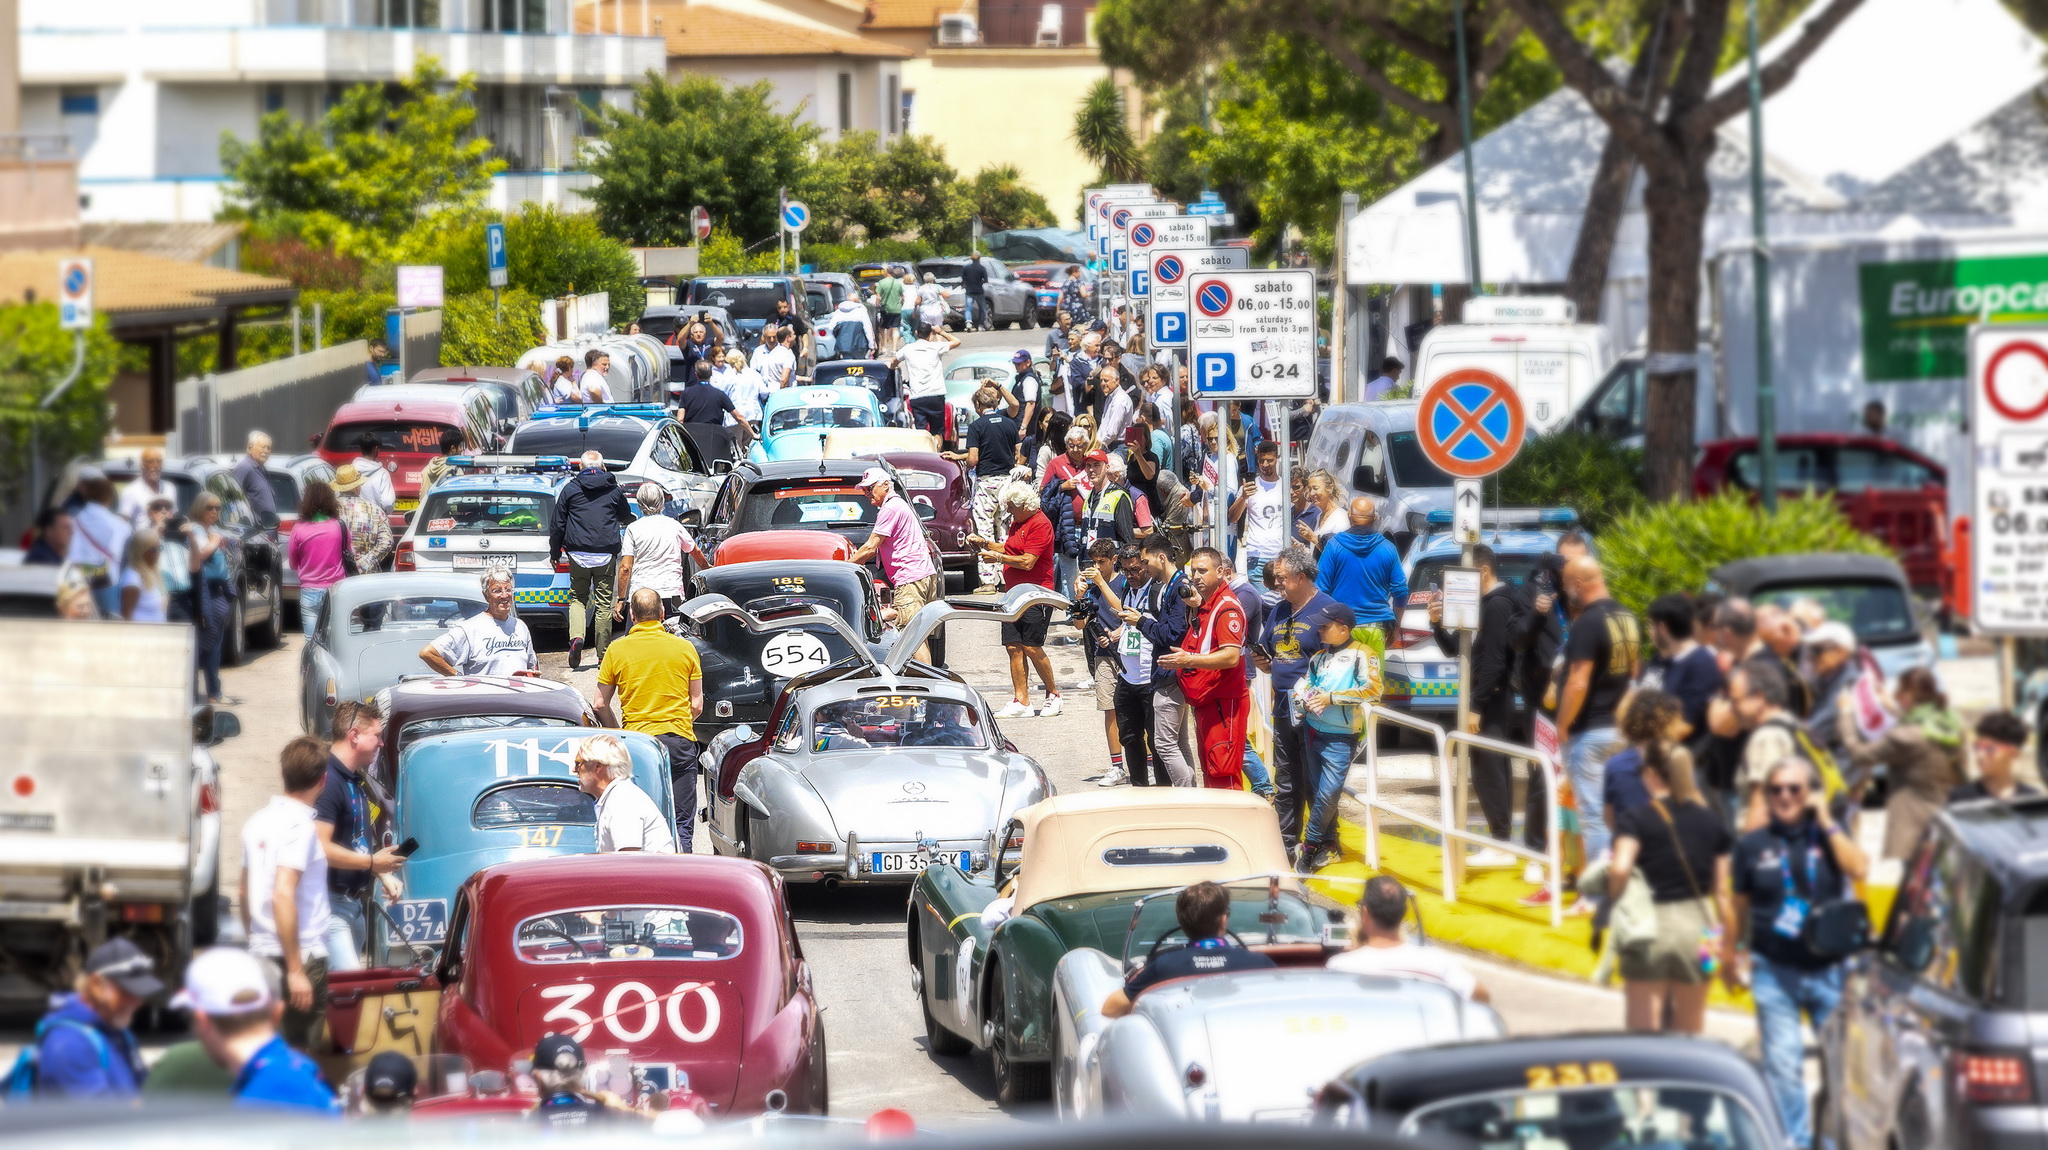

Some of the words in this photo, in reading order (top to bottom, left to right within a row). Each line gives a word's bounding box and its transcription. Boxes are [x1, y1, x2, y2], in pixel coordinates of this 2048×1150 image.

[1168, 222, 1194, 231] sabato
[490, 229, 502, 266] P
[1200, 256, 1231, 265] sabato
[1254, 280, 1293, 293] sabato
[1238, 298, 1270, 311] 06.00
[1495, 308, 1544, 317] RIVACOLD
[1255, 315, 1292, 325] saturdays
[1162, 315, 1181, 339] P
[1239, 325, 1257, 333] from
[1205, 357, 1228, 387] P
[1250, 363, 1300, 379] 0-24
[447, 496, 533, 504] POLIZIA
[771, 577, 805, 585] 185
[766, 645, 828, 667] 554
[875, 696, 921, 708] 254
[519, 825, 565, 848] 147
[884, 854, 903, 871] GD
[403, 903, 432, 922] DZ
[540, 981, 721, 1043] 300
